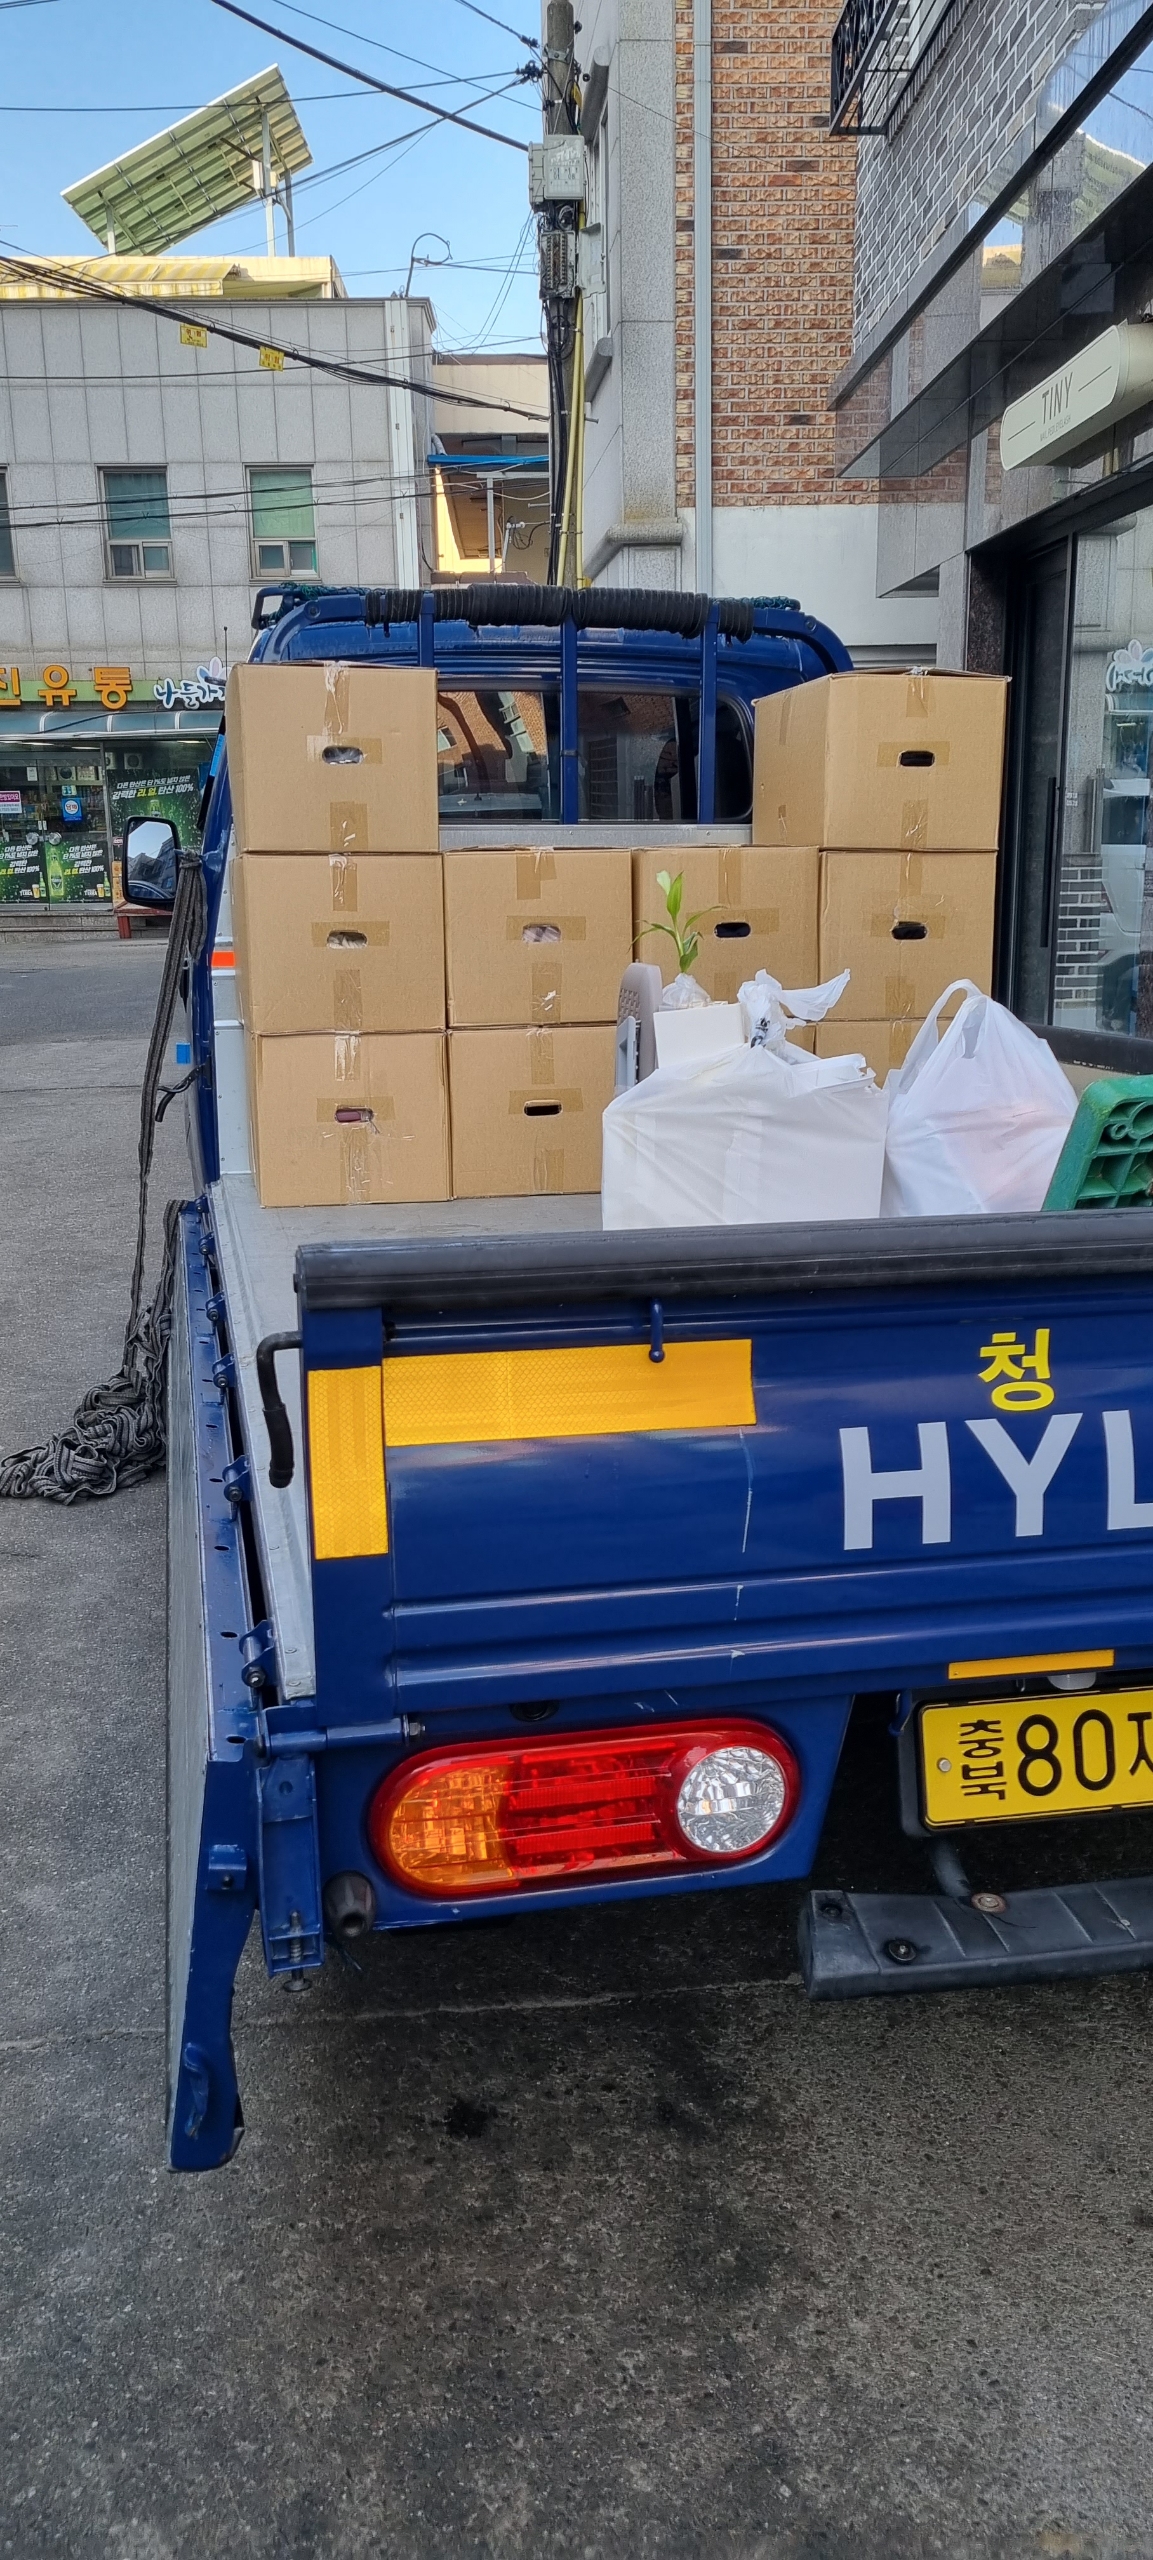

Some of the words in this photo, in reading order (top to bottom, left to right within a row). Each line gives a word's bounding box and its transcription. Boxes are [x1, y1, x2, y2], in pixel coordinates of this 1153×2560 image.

[1042, 371, 1073, 425] TINY
[175, 784, 194, 793] 100%
[978, 1328, 1055, 1412] 청
[958, 1720, 1007, 1801] 충북
